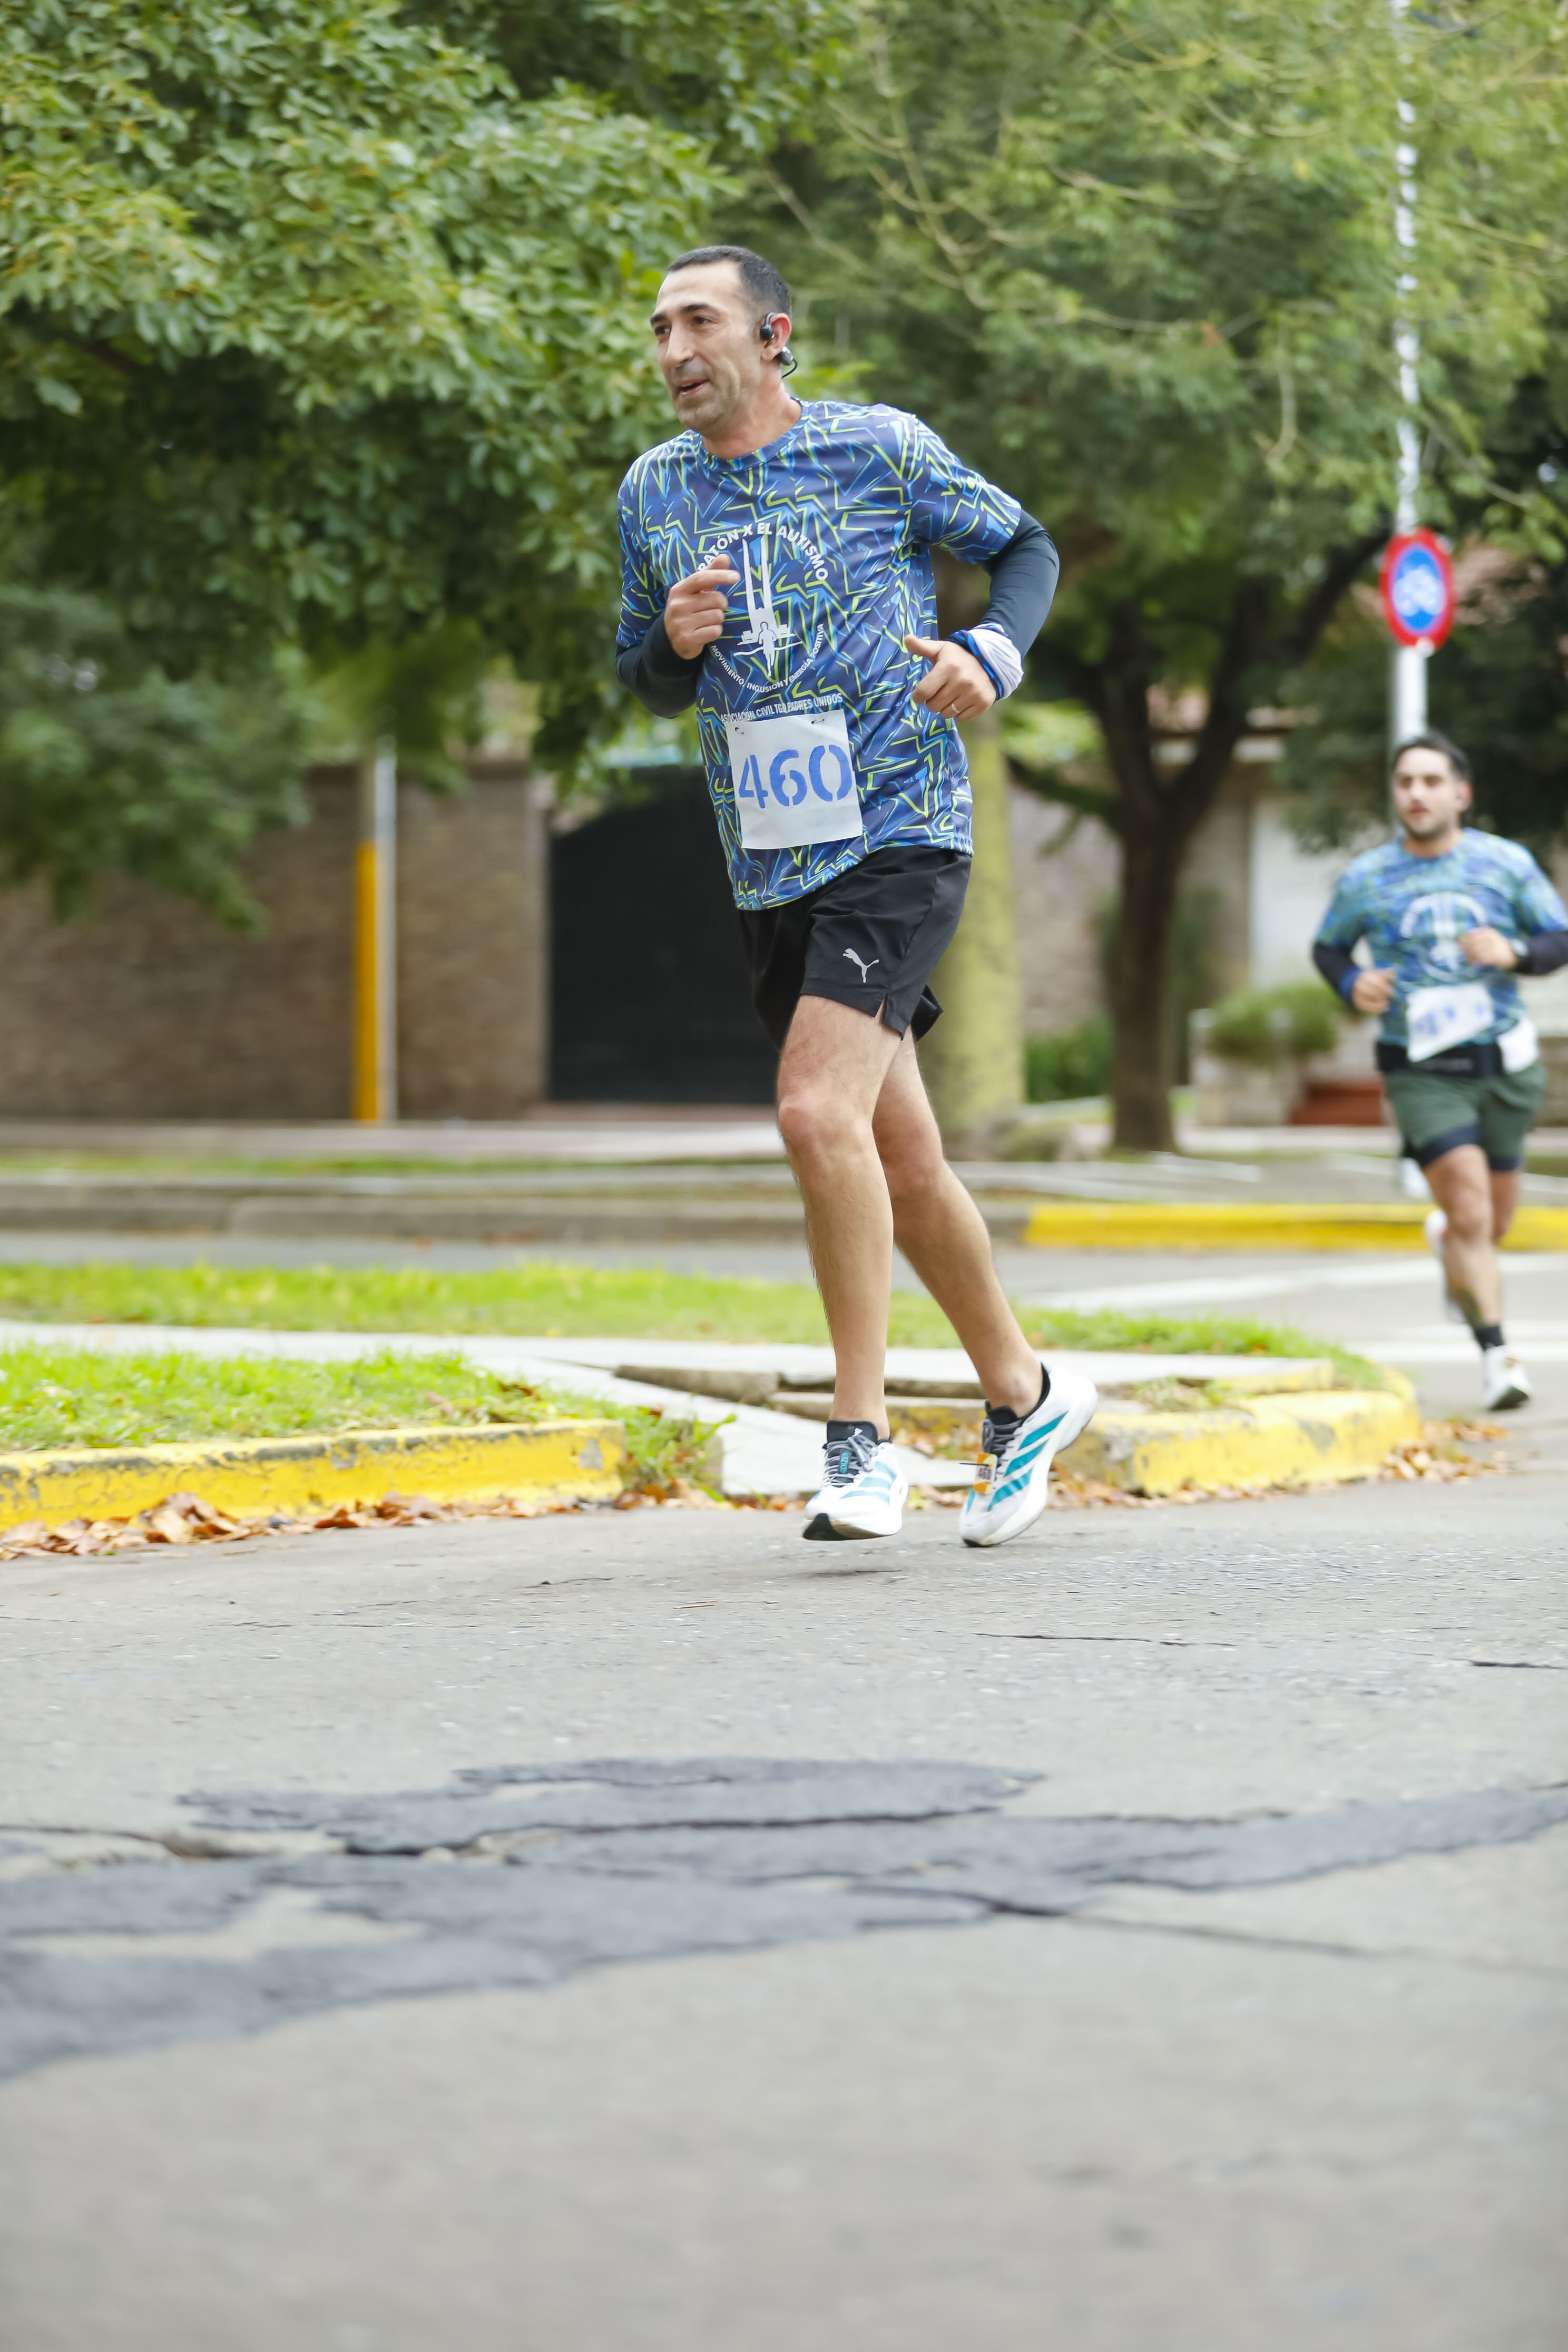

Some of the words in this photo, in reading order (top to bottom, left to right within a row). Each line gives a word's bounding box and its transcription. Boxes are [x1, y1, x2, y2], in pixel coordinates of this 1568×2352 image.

[697, 528, 740, 572] RATÓN
[742, 523, 753, 537] X
[757, 522, 773, 535] EL
[776, 525, 829, 580] AUTISMO
[711, 645, 745, 687] MOVIMIENTO,
[747, 681, 784, 693] INCLUSIÓN
[789, 658, 814, 683] ENERGÍA
[810, 623, 824, 659] POSITIVA
[720, 708, 756, 723] ASOCIACIÓN
[756, 704, 776, 717] CIVIL
[774, 702, 787, 714] TGD
[787, 698, 813, 712] PADRES
[813, 692, 843, 708] UNIDOS
[738, 744, 852, 809] 460
